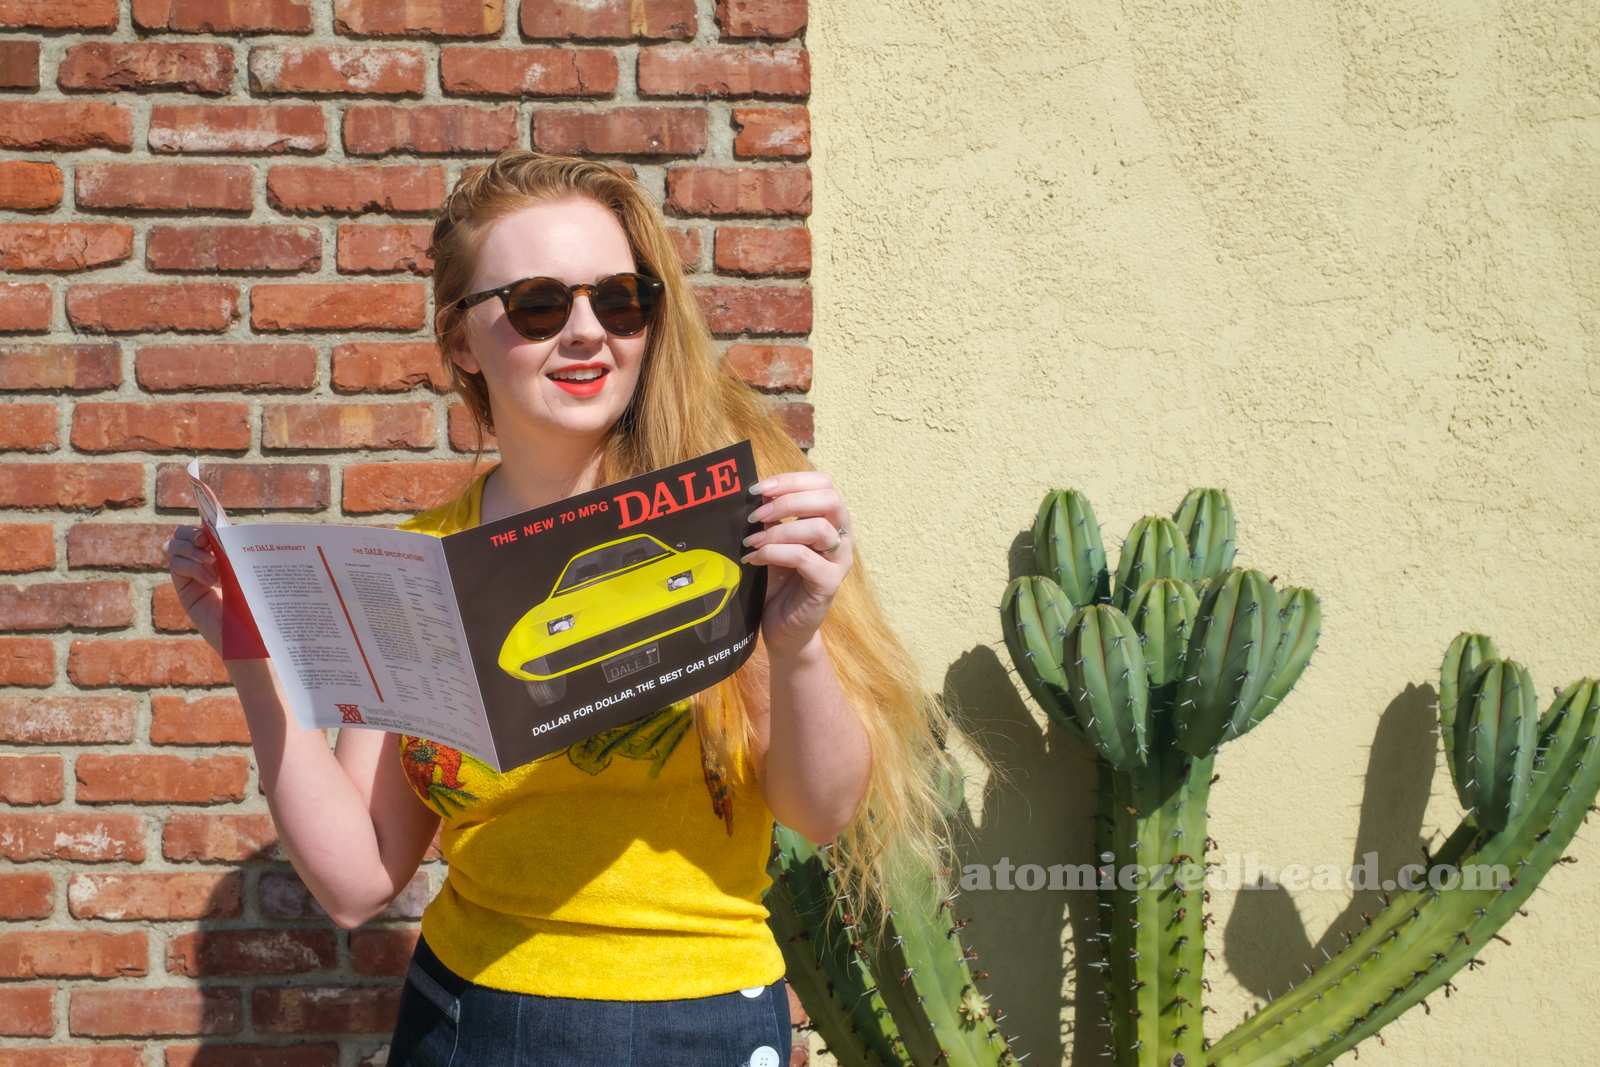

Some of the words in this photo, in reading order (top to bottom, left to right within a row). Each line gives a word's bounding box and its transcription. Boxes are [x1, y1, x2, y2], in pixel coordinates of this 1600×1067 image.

[490, 530, 518, 547] THE
[523, 518, 554, 537] NEW
[560, 511, 576, 524] 70
[578, 501, 609, 518] MPG
[613, 458, 742, 530] DALE
[532, 714, 571, 736] DOLLAR
[573, 705, 594, 720] FOR
[594, 688, 636, 710] DOLLAR,
[636, 680, 656, 694] THE
[659, 668, 684, 685] BEST
[686, 660, 706, 674] CAR
[707, 649, 731, 665] EVER
[610, 658, 644, 678] DALE
